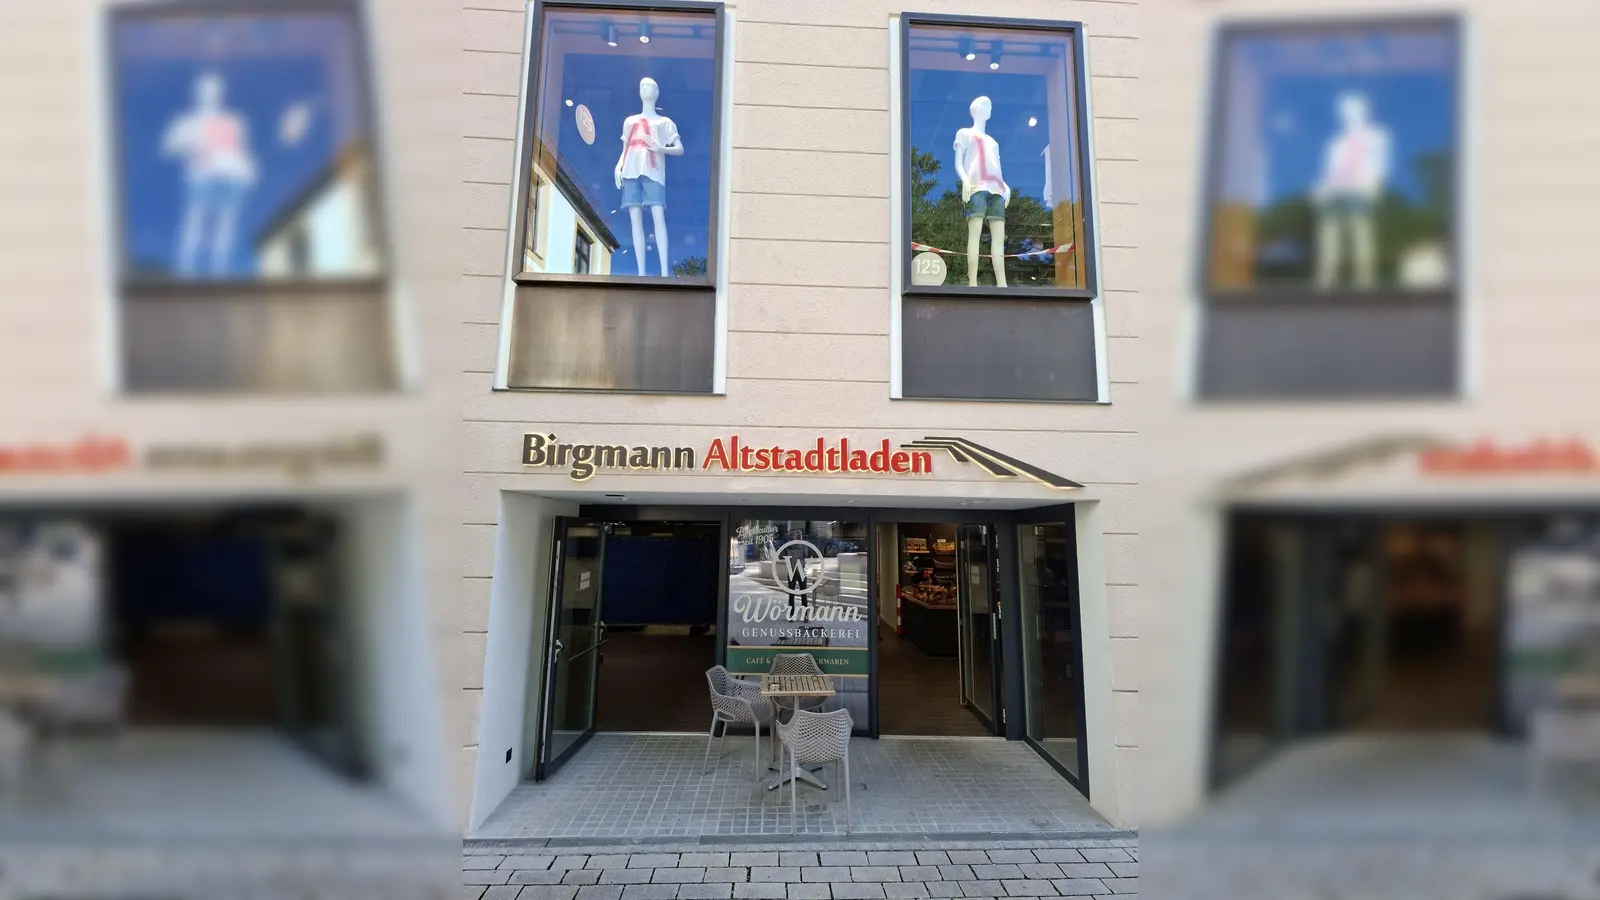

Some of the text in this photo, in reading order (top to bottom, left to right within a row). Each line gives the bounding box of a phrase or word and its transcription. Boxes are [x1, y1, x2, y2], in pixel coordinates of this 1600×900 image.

[915, 259, 941, 275] 125
[522, 433, 933, 480] Birgmann Altstadtladen
[755, 533, 774, 545] 1905
[782, 555, 807, 583] W
[733, 595, 862, 624] Wörmann
[742, 626, 860, 639] GENUSSBÄCKEREI
[746, 655, 765, 664] CAFÉ
